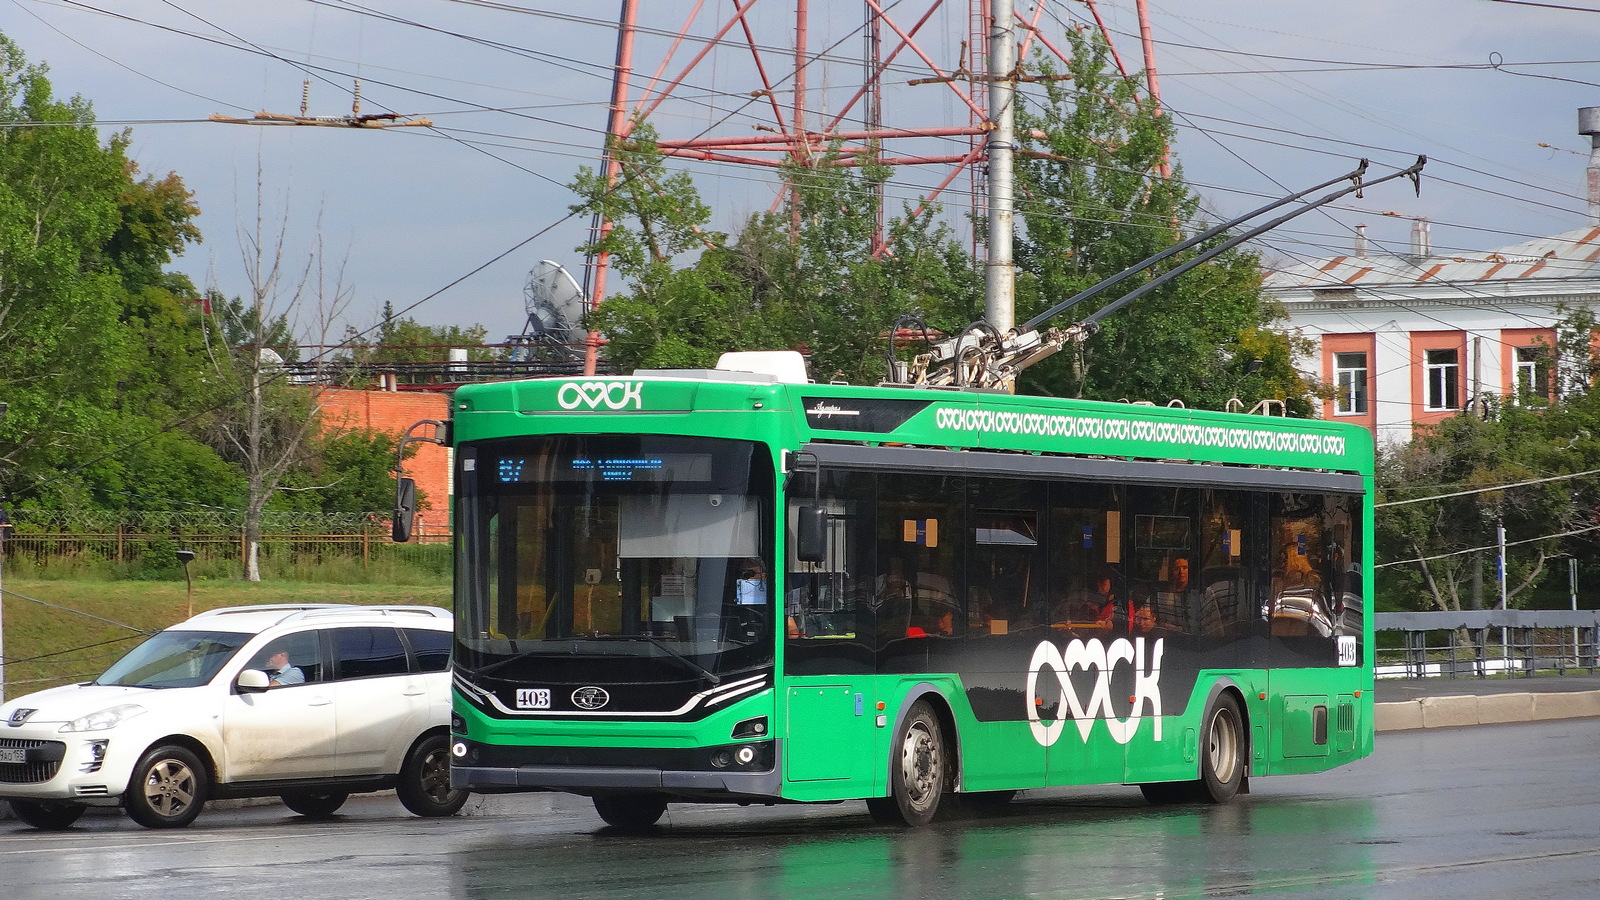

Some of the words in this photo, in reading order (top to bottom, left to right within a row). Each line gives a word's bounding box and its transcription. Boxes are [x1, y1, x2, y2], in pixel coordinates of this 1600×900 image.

[557, 381, 644, 410] ОМСК
[1337, 641, 1355, 662] 403
[518, 690, 549, 707] 403
[1026, 636, 1164, 747] ОМСК
